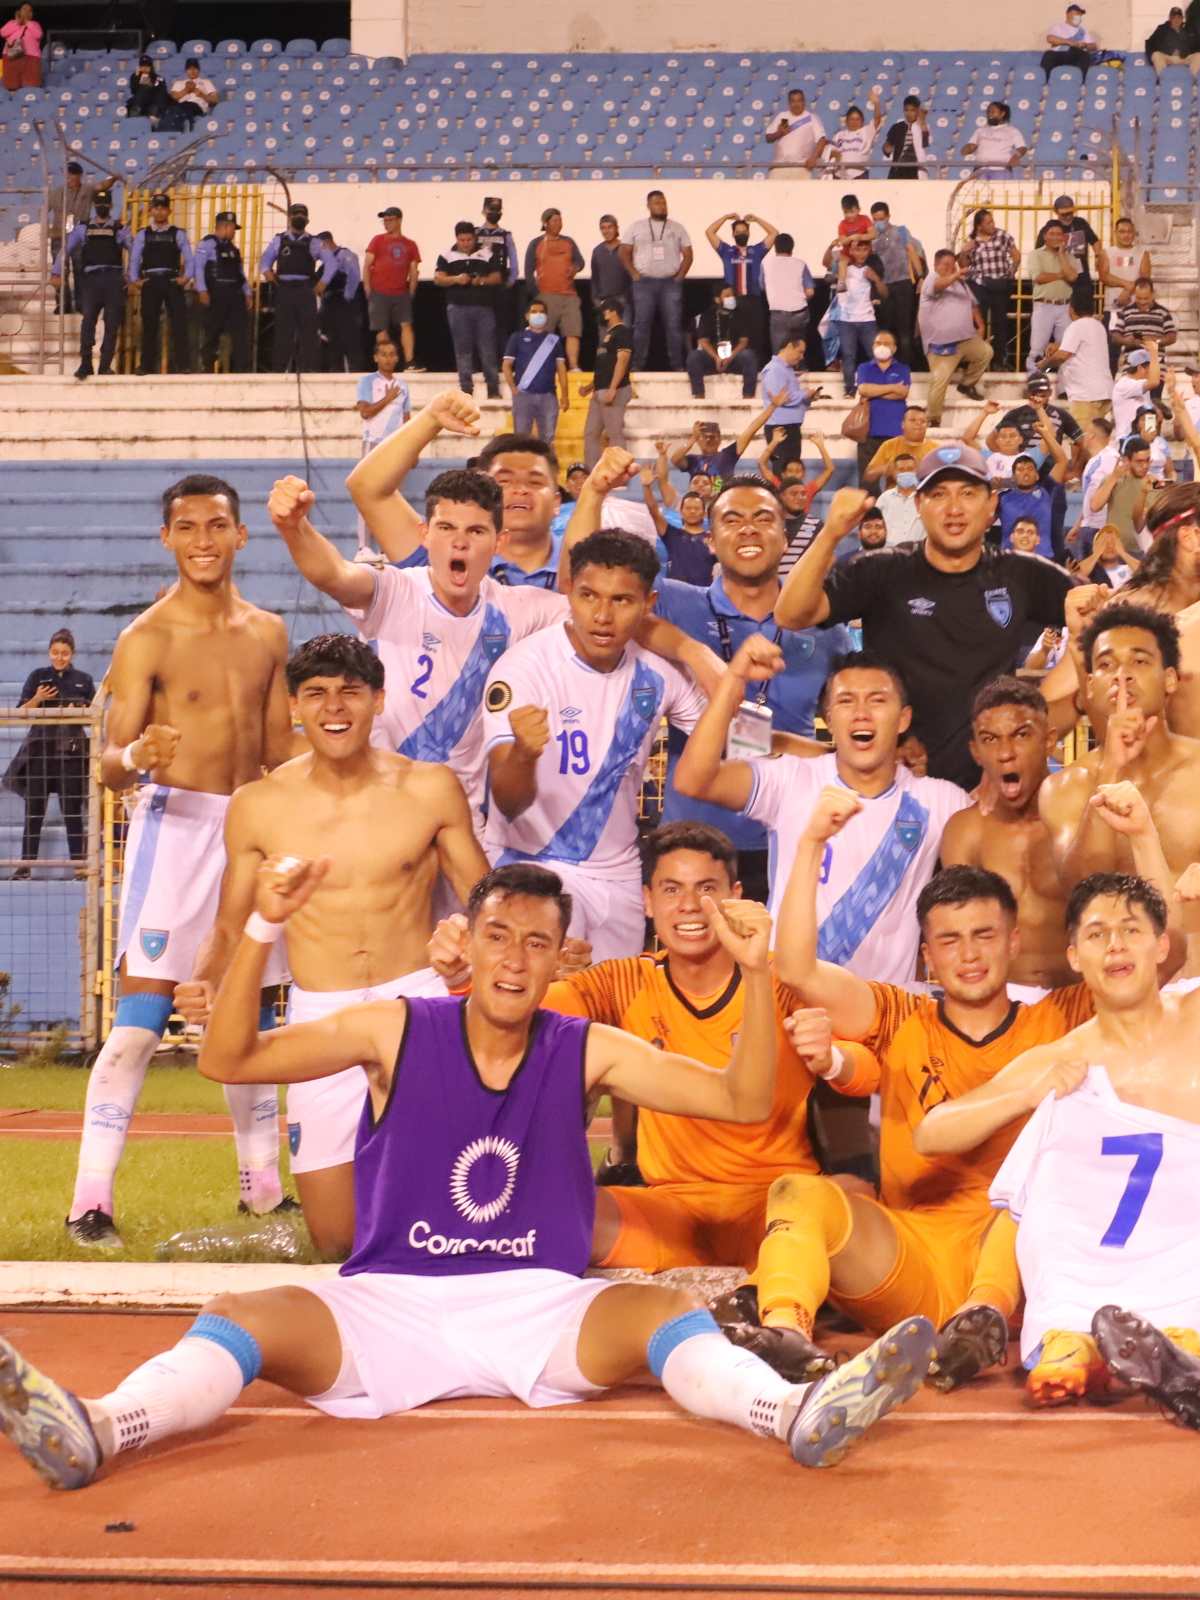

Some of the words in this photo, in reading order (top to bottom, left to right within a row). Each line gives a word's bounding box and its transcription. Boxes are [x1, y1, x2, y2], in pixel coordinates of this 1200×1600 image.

[410, 654, 435, 699] 2
[556, 730, 591, 776] 19
[1100, 1132, 1164, 1249] 7
